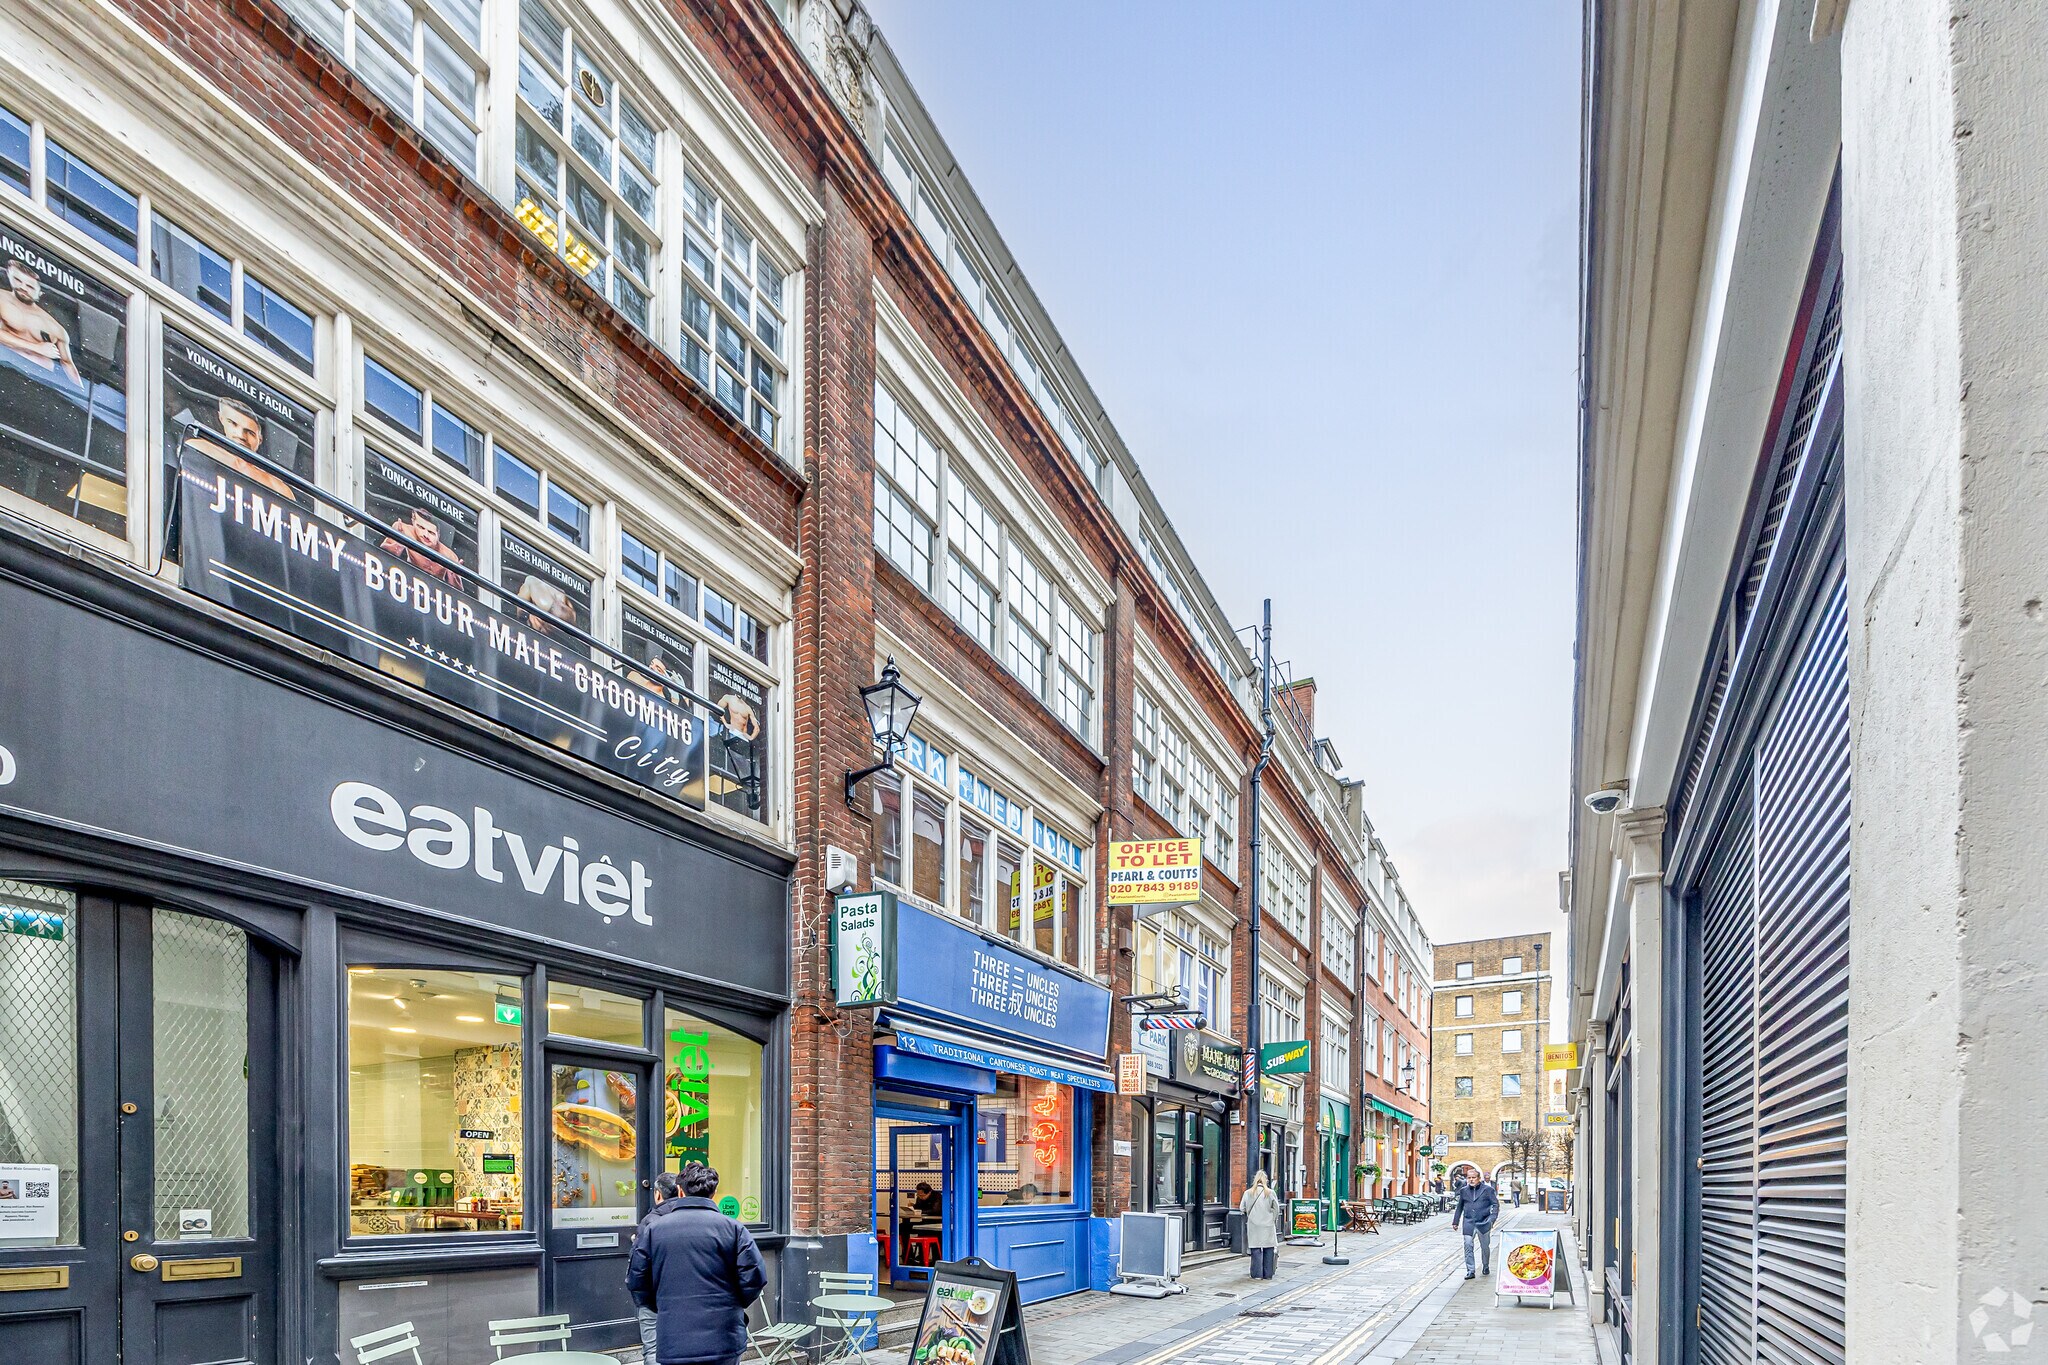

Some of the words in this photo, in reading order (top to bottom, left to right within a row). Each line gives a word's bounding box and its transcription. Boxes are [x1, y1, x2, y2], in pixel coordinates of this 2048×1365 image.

[186, 347, 225, 380] YONKA
[227, 371, 257, 399] MALE
[260, 391, 294, 421] FACIAL
[380, 463, 414, 493] YONKA
[415, 485, 439, 507] SKIN
[440, 501, 465, 523] CARE
[504, 538, 531, 563] LASER
[531, 554, 551, 574] HAIR
[551, 563, 587, 596] REMOVAL
[209, 474, 346, 572] JIMMY
[364, 551, 475, 639] BODUR
[488, 616, 563, 682] MALE
[573, 661, 693, 746] GROOMING
[656, 629, 690, 656] TREATMENTS
[718, 663, 733, 679] MALE
[614, 735, 690, 787] City
[1117, 855, 1145, 868] TO
[1152, 853, 1193, 866] LET
[1120, 841, 1189, 854] OFFICE
[1110, 884, 1132, 893] 020
[1136, 882, 1165, 892] 7843
[1168, 881, 1199, 891] 9189
[1111, 870, 1144, 882] PEARL
[1146, 870, 1155, 880] &
[1158, 868, 1198, 880] COUTTS
[840, 902, 878, 918] Pasta
[840, 917, 875, 932] Salads
[974, 950, 1010, 979] THREE
[1026, 972, 1060, 998] UNCLES
[972, 968, 1009, 996] THREE
[1025, 988, 1058, 1013] UNCLES
[970, 986, 1008, 1013] THREE
[1024, 1004, 1056, 1029] UNCLES
[1150, 1030, 1166, 1047] PARK
[901, 1036, 916, 1050] 12
[932, 1044, 986, 1064] TRADITIONAL
[989, 1057, 1027, 1072] CANTONESE
[1029, 1066, 1048, 1077] ROAST
[1050, 1070, 1064, 1080] MEAT
[1066, 1074, 1101, 1088] SPECIALISTS
[1265, 1045, 1308, 1070] SUBWAY
[465, 1130, 490, 1139] OPEN
